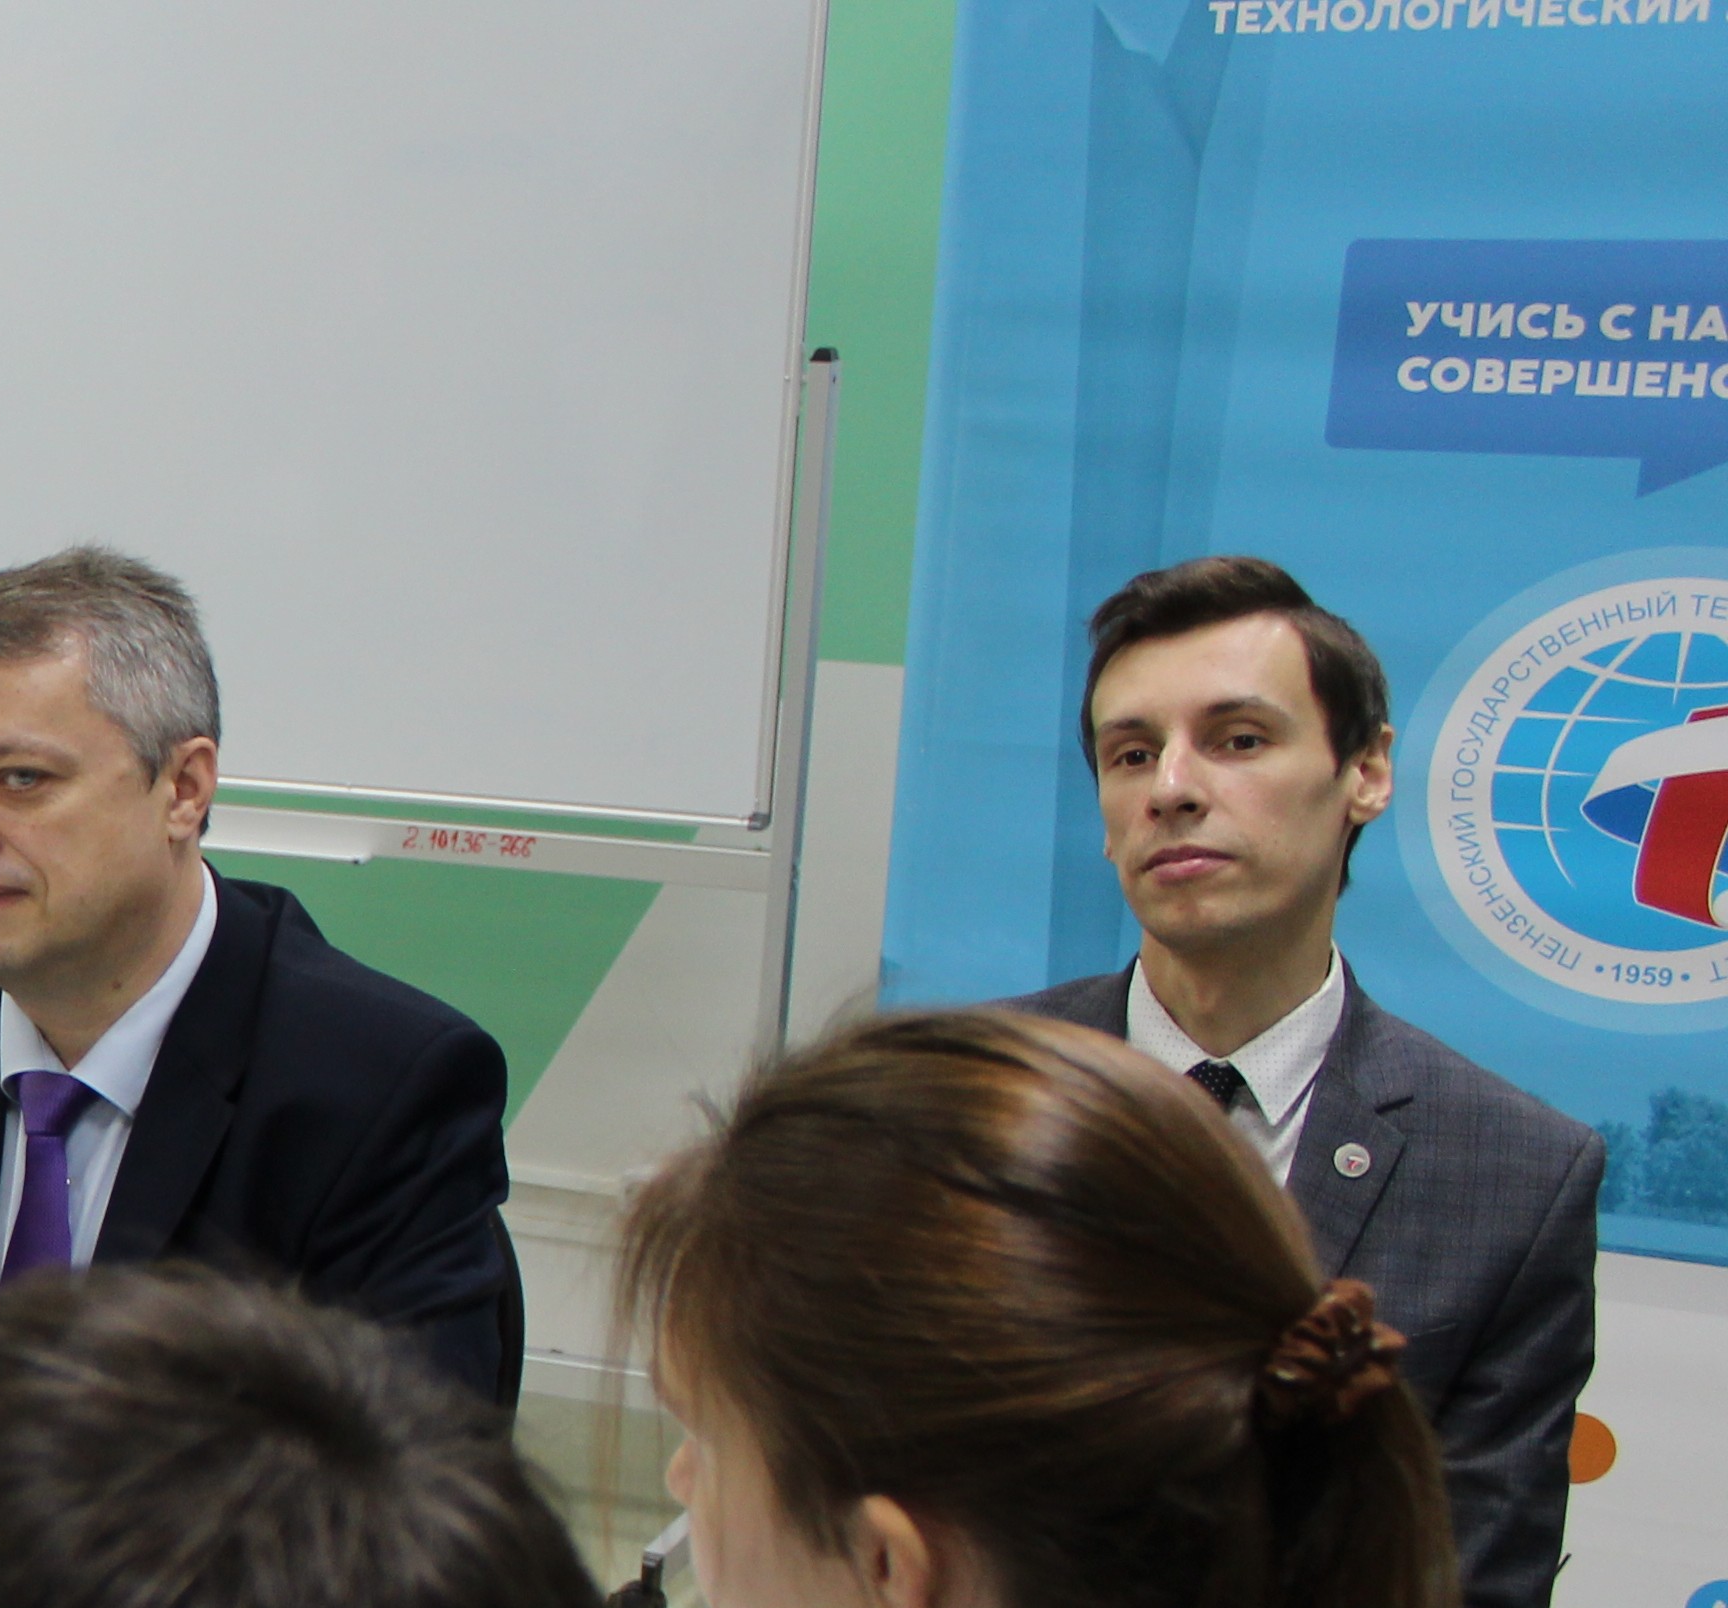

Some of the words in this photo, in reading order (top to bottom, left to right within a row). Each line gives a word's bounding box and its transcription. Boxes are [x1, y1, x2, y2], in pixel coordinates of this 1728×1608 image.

[1405, 301, 1586, 340] УЧИСЬ
[1599, 303, 1637, 341] С
[1450, 590, 1677, 802] ГОСУДАРСТВЕННЫЙ
[1447, 809, 1582, 971] ПЕНЗЕНСКИЙ
[1611, 963, 1673, 987] 1959
